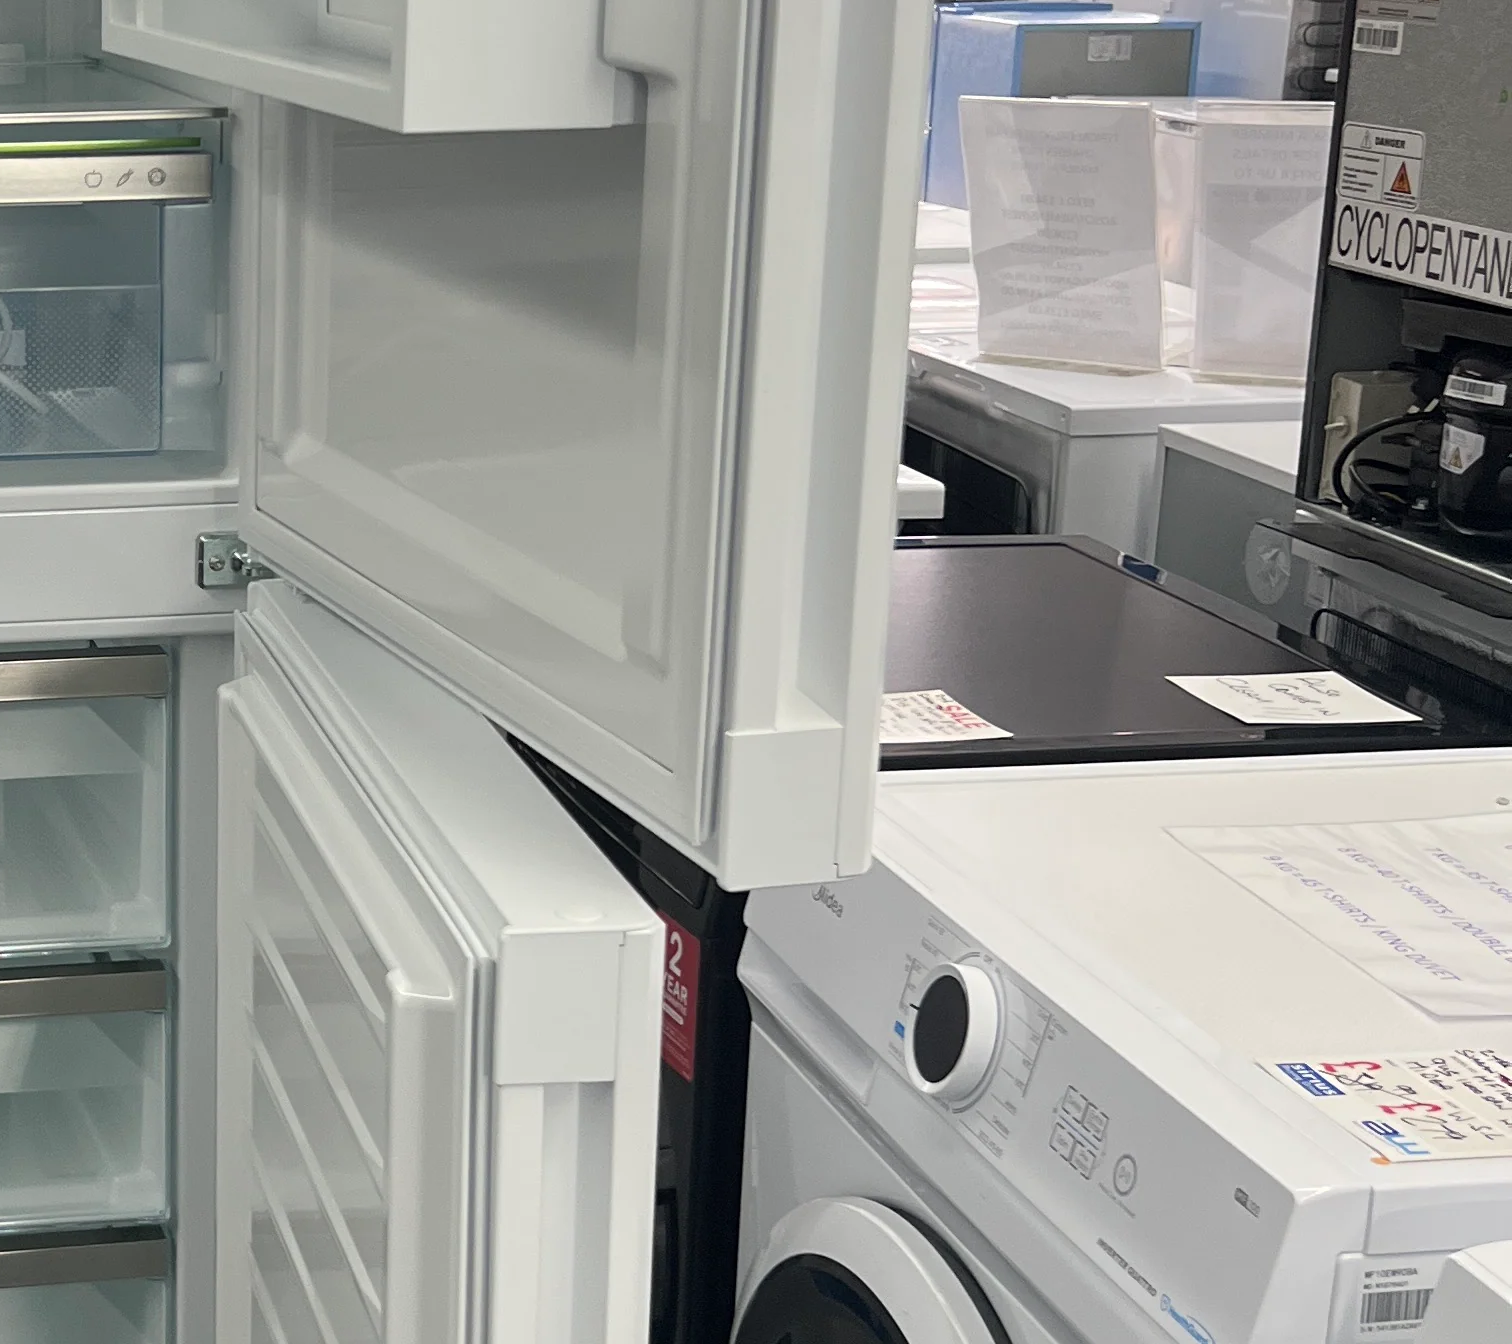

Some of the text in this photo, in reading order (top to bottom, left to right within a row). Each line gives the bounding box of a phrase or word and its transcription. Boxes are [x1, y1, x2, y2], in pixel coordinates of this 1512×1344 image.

[1374, 136, 1406, 149] DANGER
[944, 704, 991, 729] SALE
[812, 885, 844, 918] Midea
[1393, 878, 1454, 916] T-SHIRTS
[1452, 921, 1512, 955] DOUBLE
[1272, 860, 1299, 874] KG
[1301, 877, 1324, 888] 45
[1316, 887, 1377, 924] T-SHIRTS
[1372, 929, 1416, 954] KING
[1405, 953, 1462, 982] DUVET
[668, 930, 684, 977] 2
[1289, 1063, 1339, 1096] sirius
